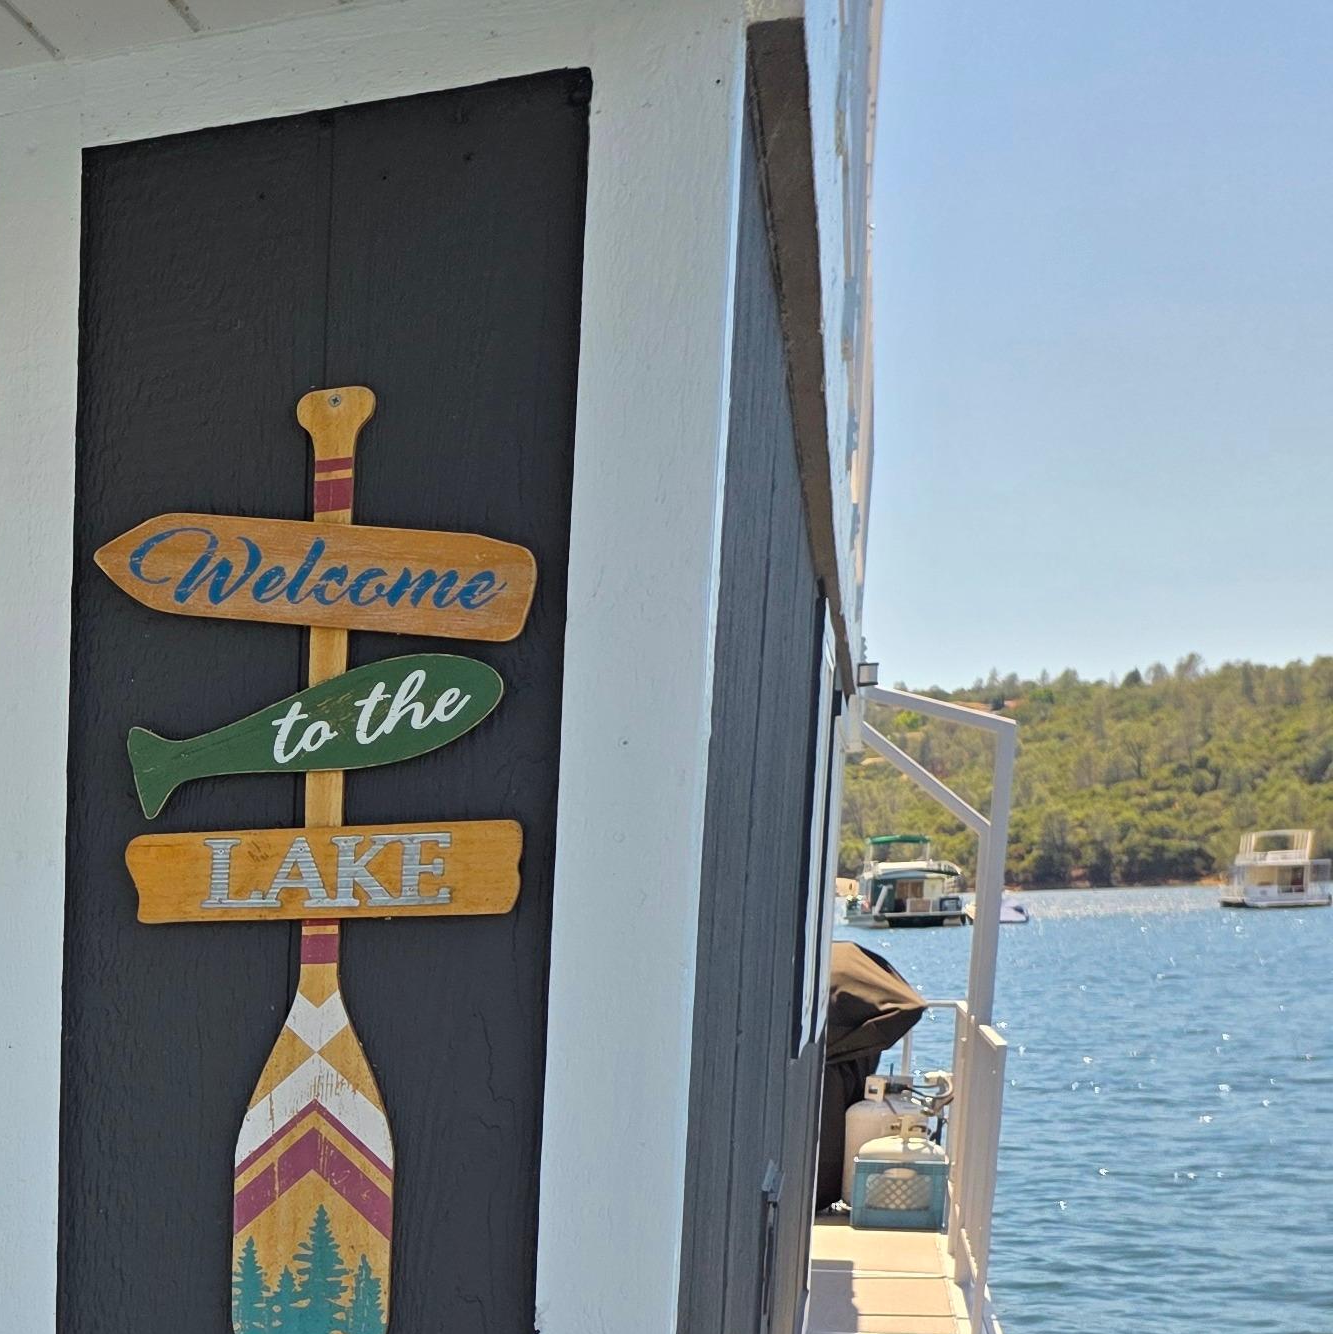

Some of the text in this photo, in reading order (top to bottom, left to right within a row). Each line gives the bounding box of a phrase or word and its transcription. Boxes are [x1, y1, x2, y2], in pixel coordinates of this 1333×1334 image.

[129, 528, 507, 611] Welcome
[272, 670, 471, 763] to the
[201, 832, 452, 909] LAKE
